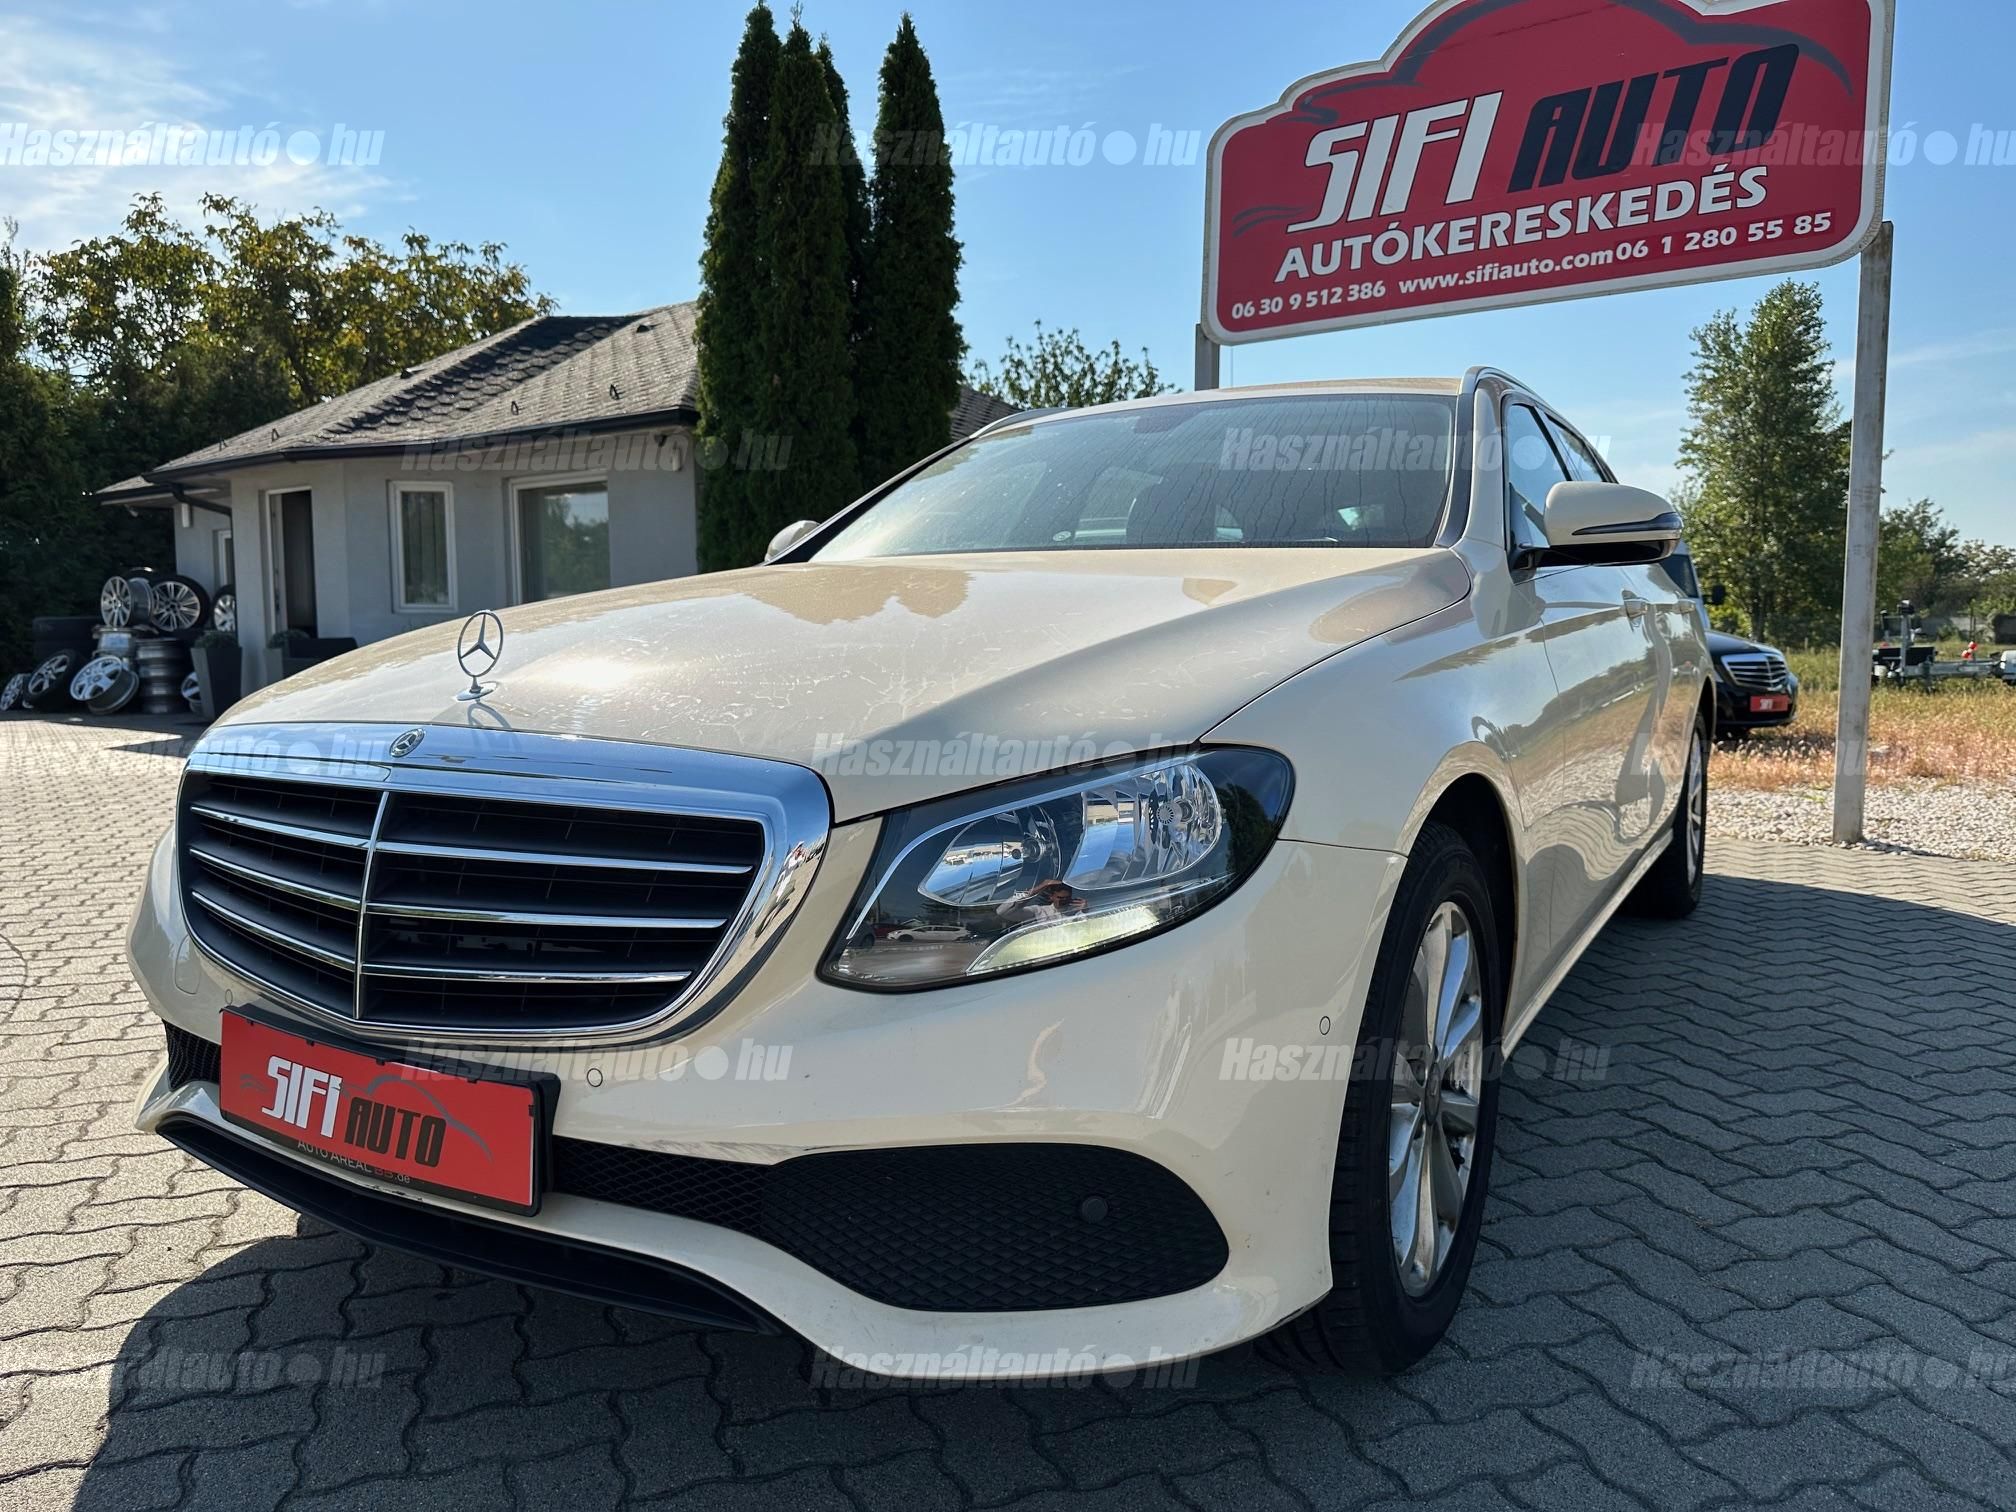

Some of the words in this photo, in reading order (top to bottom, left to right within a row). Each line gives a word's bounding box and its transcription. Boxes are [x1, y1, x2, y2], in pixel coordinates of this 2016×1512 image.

[1286, 90, 1503, 233] SIFI
[1507, 43, 1800, 194] AUTO
[1231, 301, 1255, 319] 06
[1259, 296, 1283, 315] 30
[1289, 293, 1302, 311] 9
[1306, 286, 1342, 307] 512
[1348, 280, 1386, 301] 386
[1399, 248, 1614, 294] www.sifiauto.com
[1616, 239, 1649, 261] 06
[1661, 236, 1672, 254] 1
[1684, 226, 1737, 251] 280
[1748, 219, 1784, 242] 55
[1793, 212, 1832, 235] 85
[1274, 162, 1768, 283] AUTÓKERESKEDÉS
[261, 1055, 345, 1138] SIFI
[344, 1097, 446, 1168] AUTO
